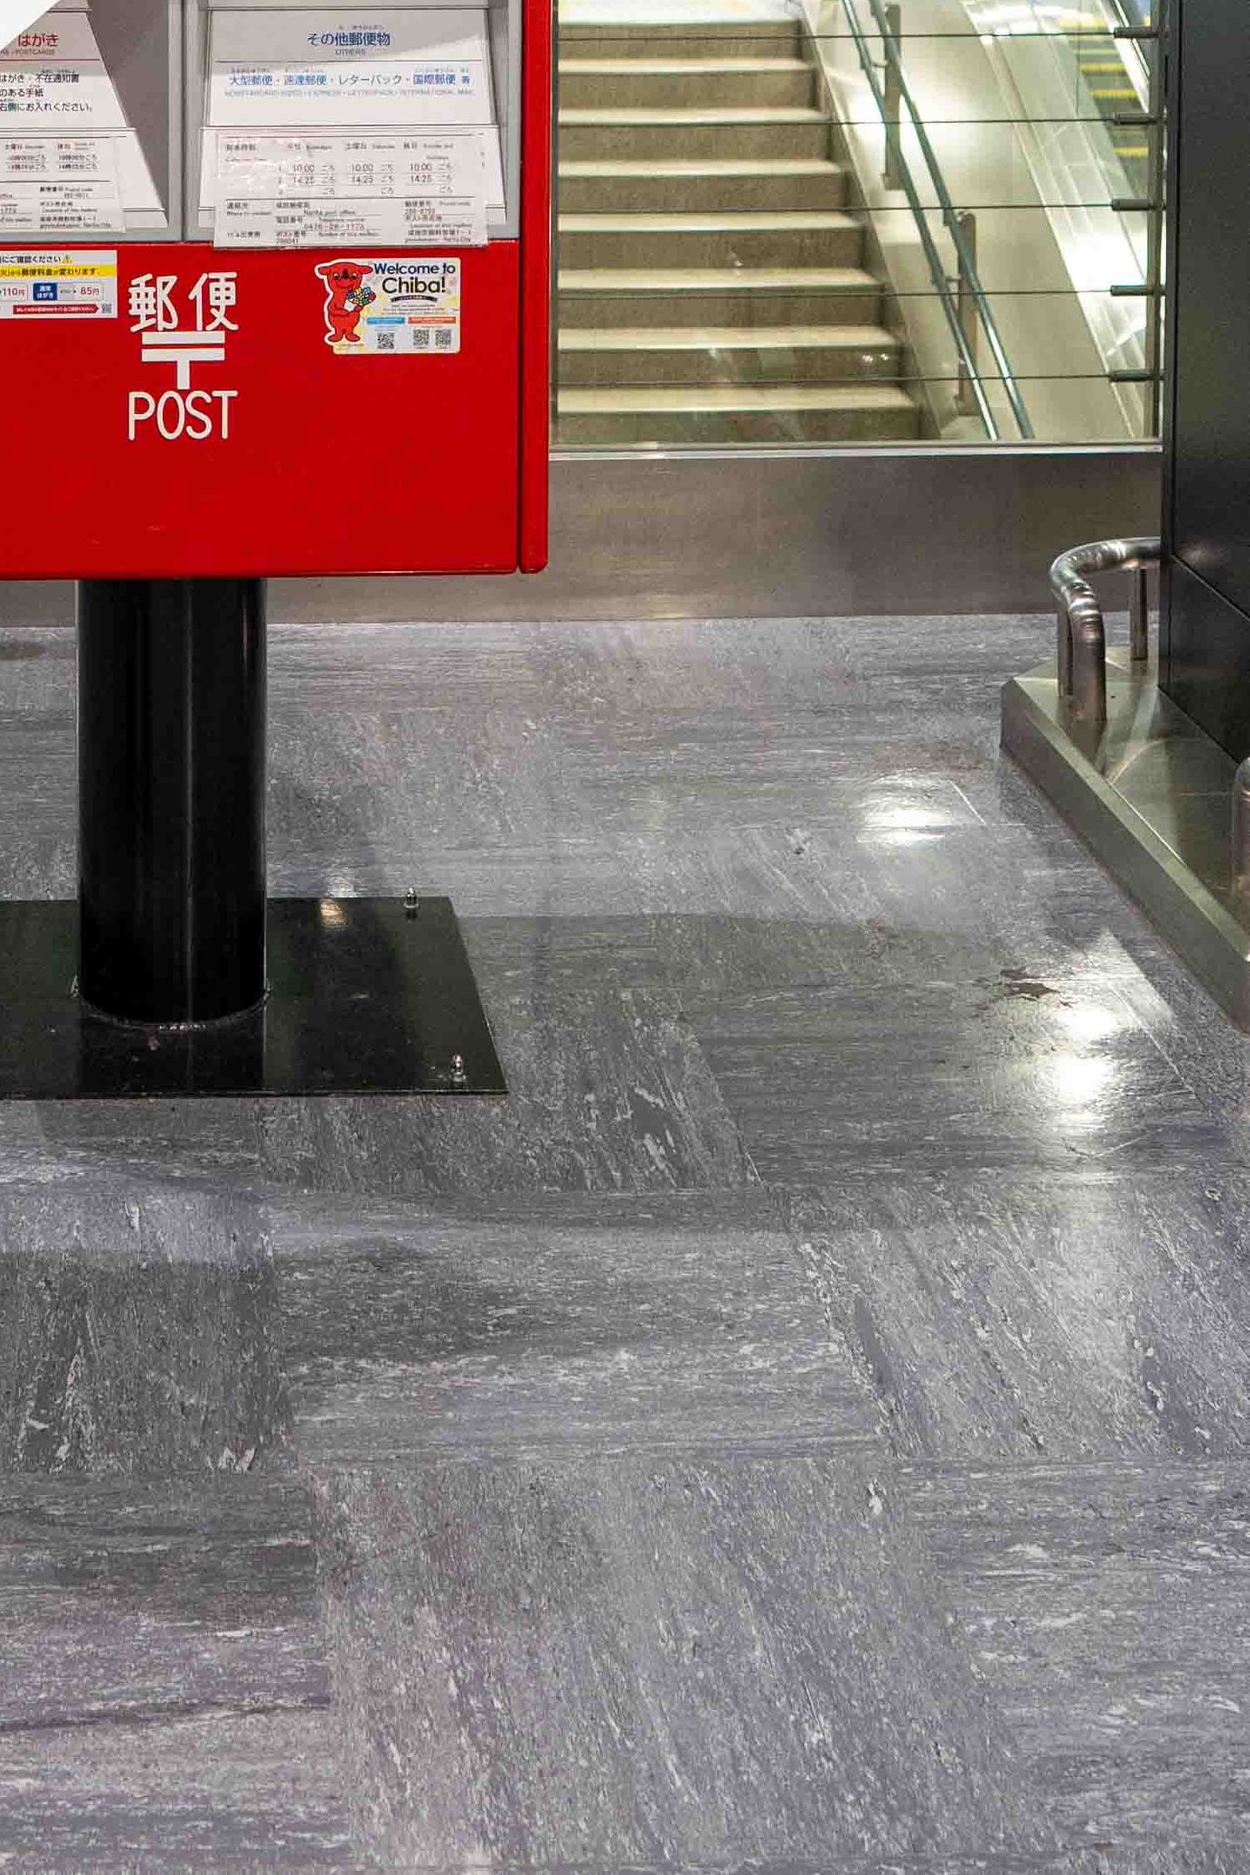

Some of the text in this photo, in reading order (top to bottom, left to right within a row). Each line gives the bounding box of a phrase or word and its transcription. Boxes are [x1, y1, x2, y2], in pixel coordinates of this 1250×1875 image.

[18, 33, 59, 47] はがき
[308, 31, 391, 46] その他郵便物
[373, 262, 456, 275] Welcome to
[2, 287, 25, 296] 110円
[80, 286, 100, 296] 85円
[382, 276, 446, 294] Chiba!
[128, 272, 240, 333] 郵便
[128, 390, 239, 441] POST
